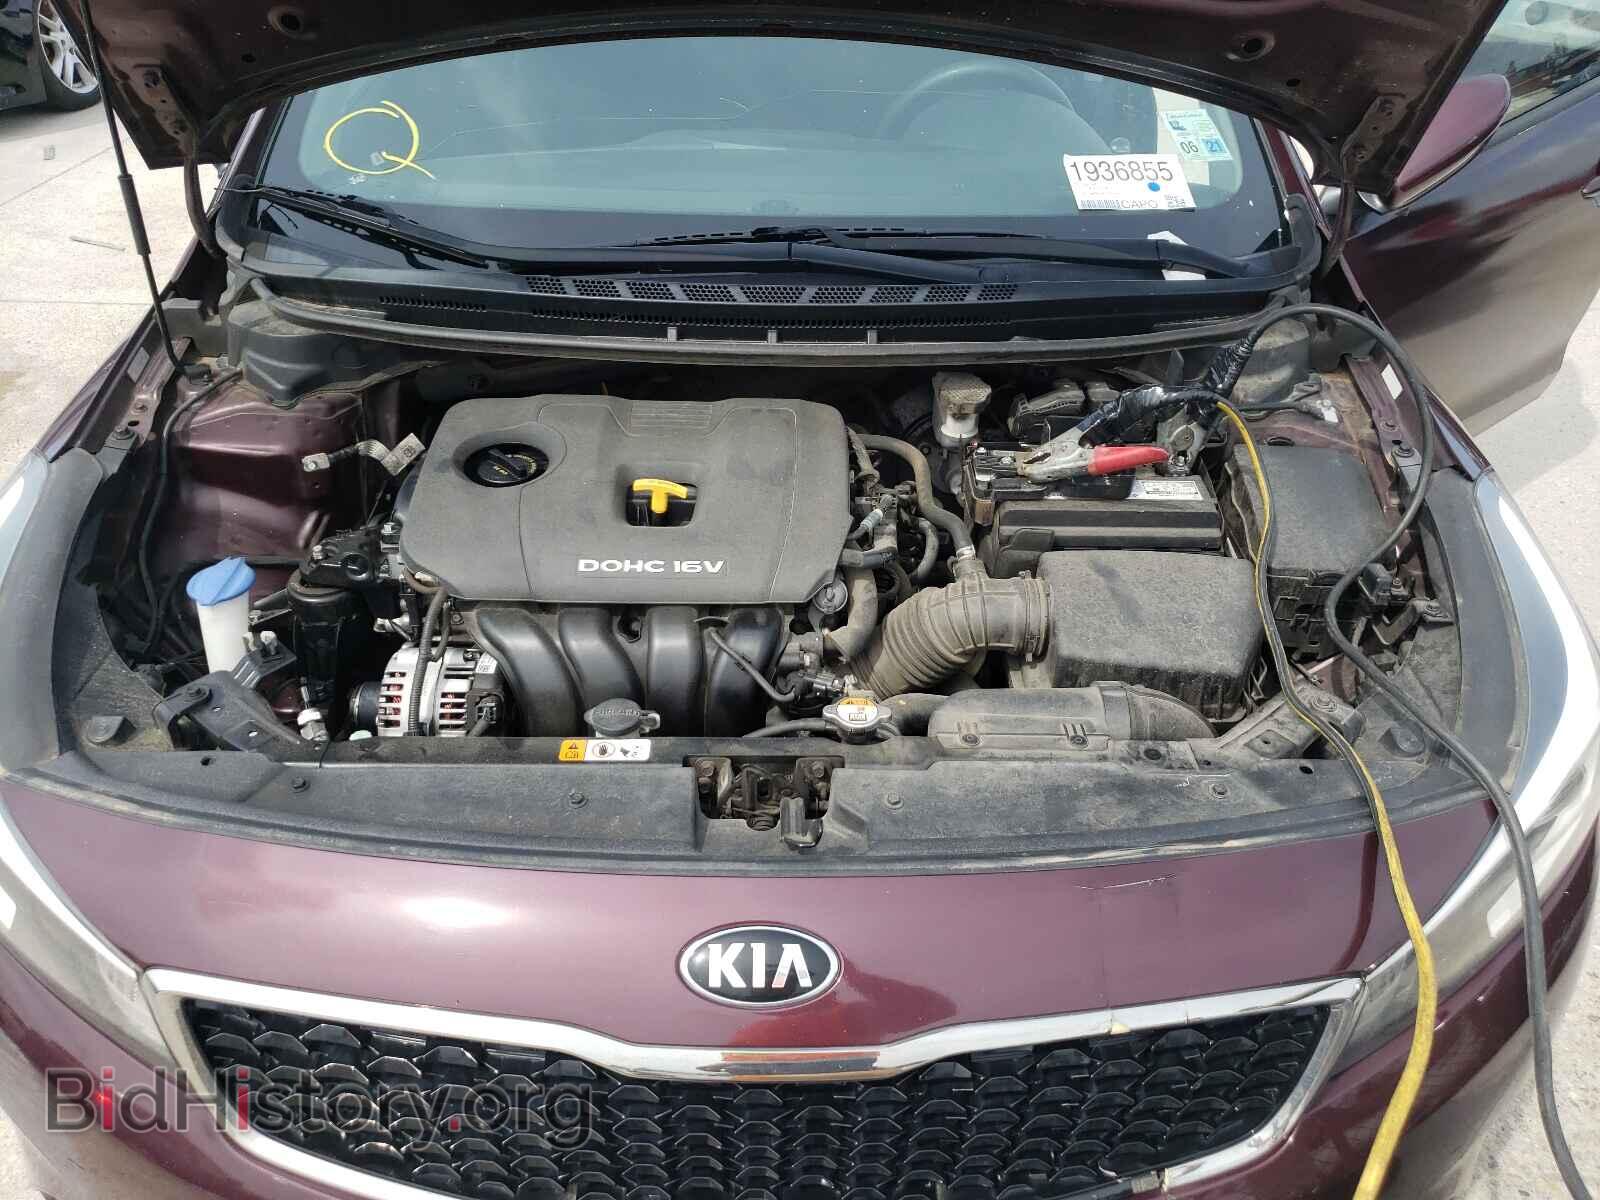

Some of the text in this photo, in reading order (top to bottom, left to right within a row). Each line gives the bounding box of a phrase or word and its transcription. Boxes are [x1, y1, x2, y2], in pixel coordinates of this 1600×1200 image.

[1180, 141, 1199, 154] 06
[1069, 160, 1174, 181] 1936855
[577, 559, 724, 573] DOHC 16V
[707, 942, 813, 988] KIA
